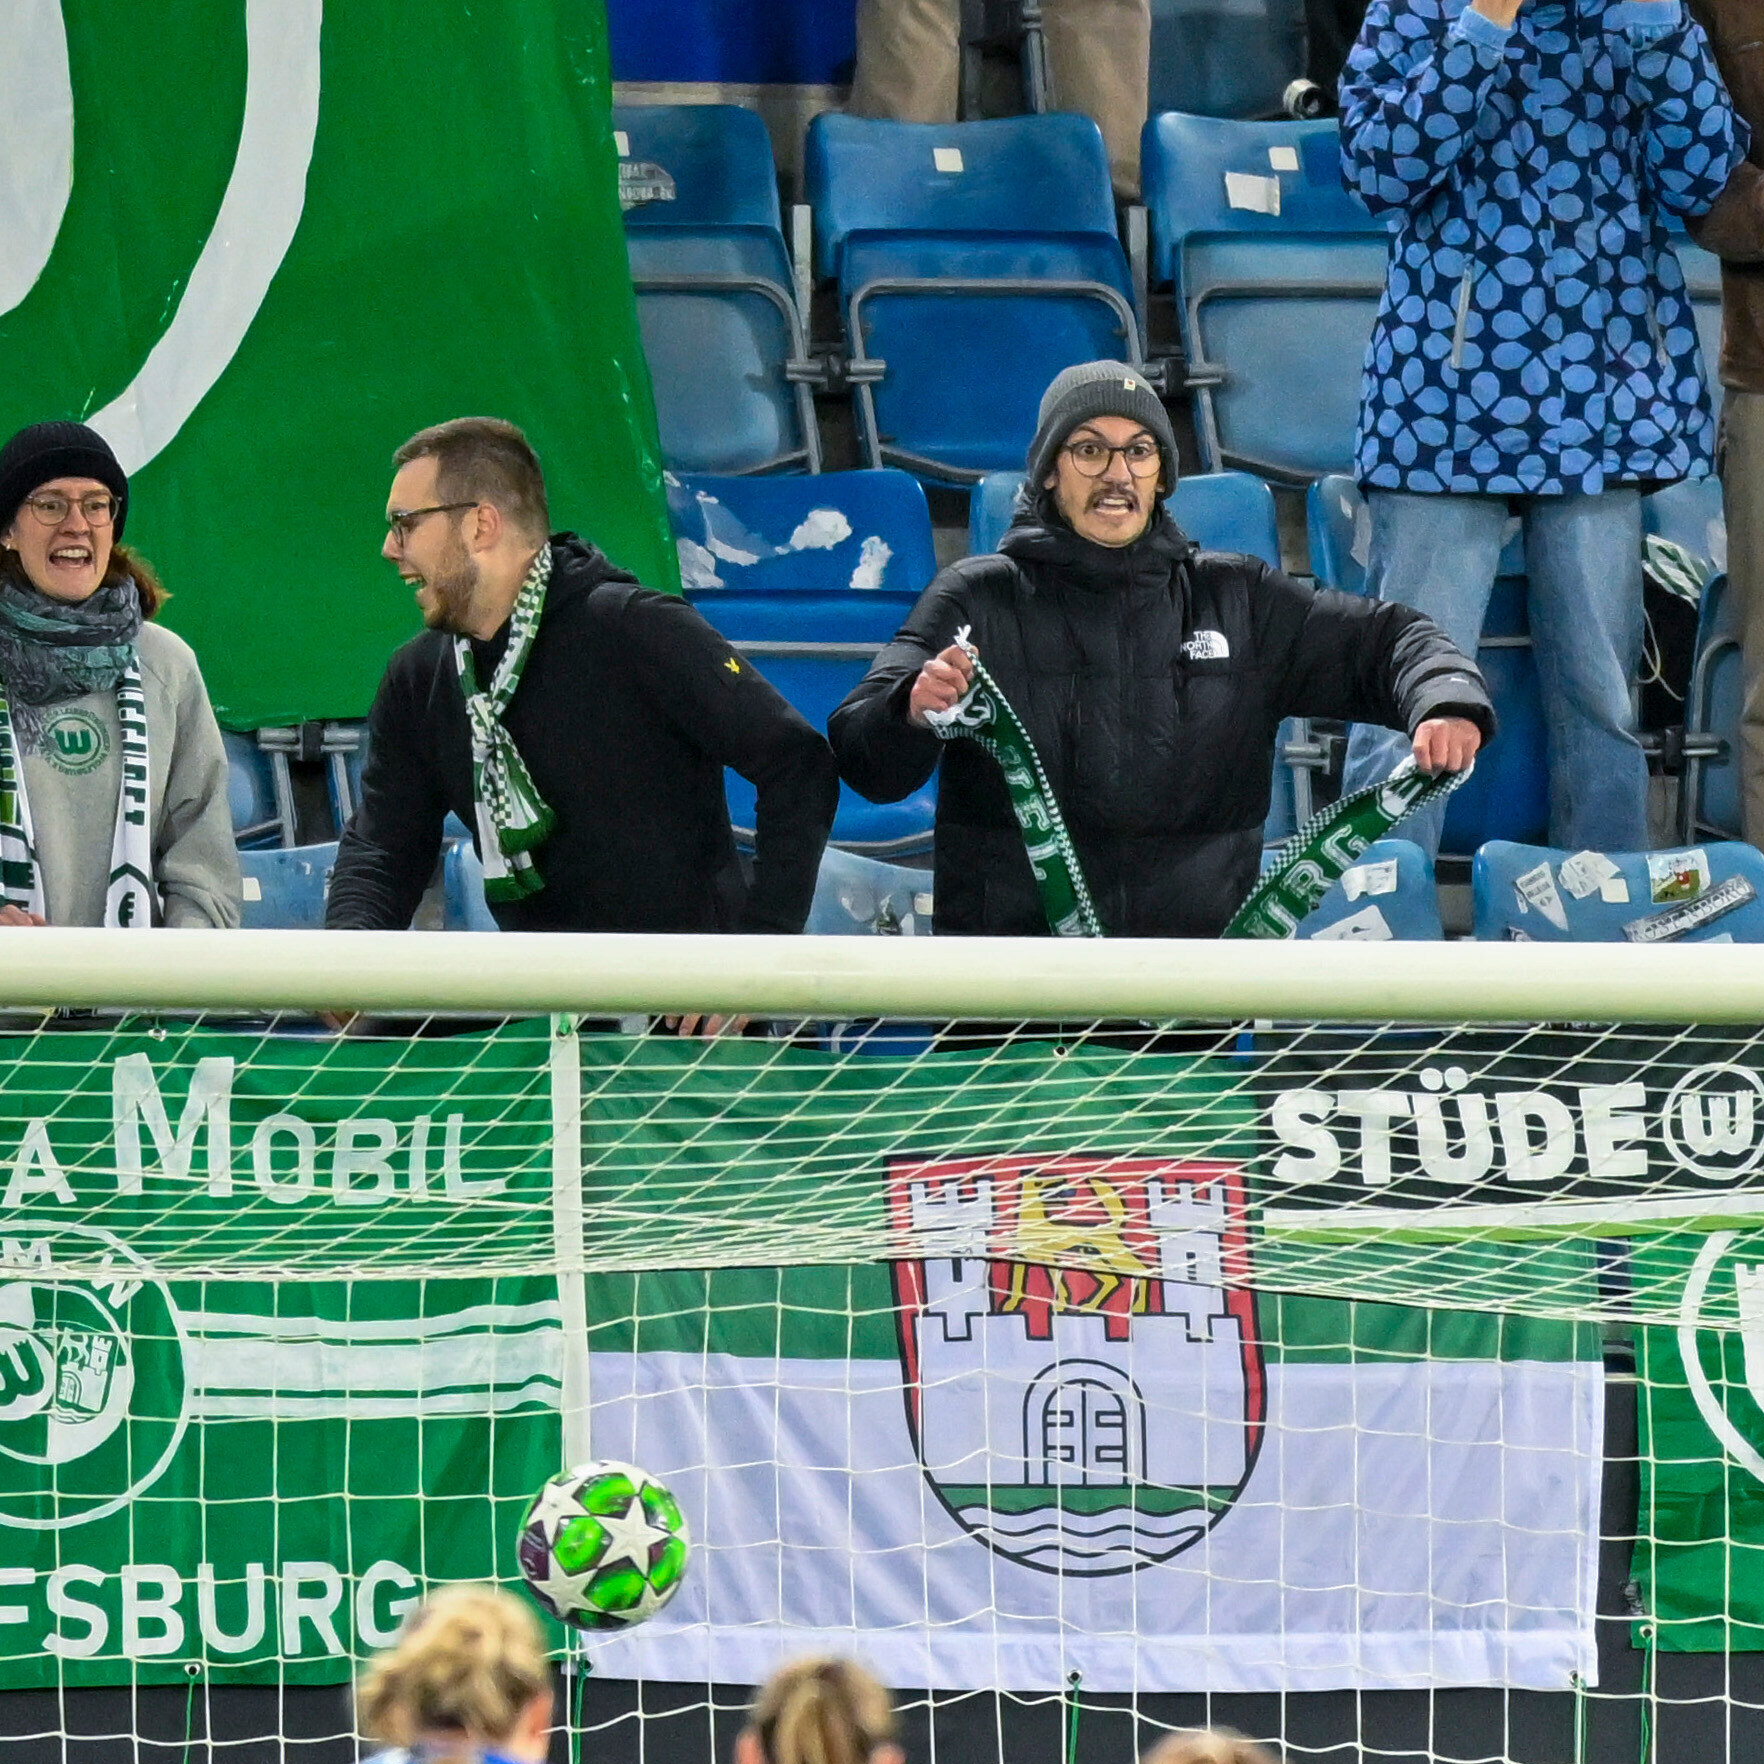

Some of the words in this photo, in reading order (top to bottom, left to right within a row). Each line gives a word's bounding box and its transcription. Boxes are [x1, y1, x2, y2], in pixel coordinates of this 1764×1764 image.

[1193, 630, 1211, 641] THE
[112, 1051, 507, 1207] MOBIL
[1271, 1068, 1649, 1187] STÜDE
